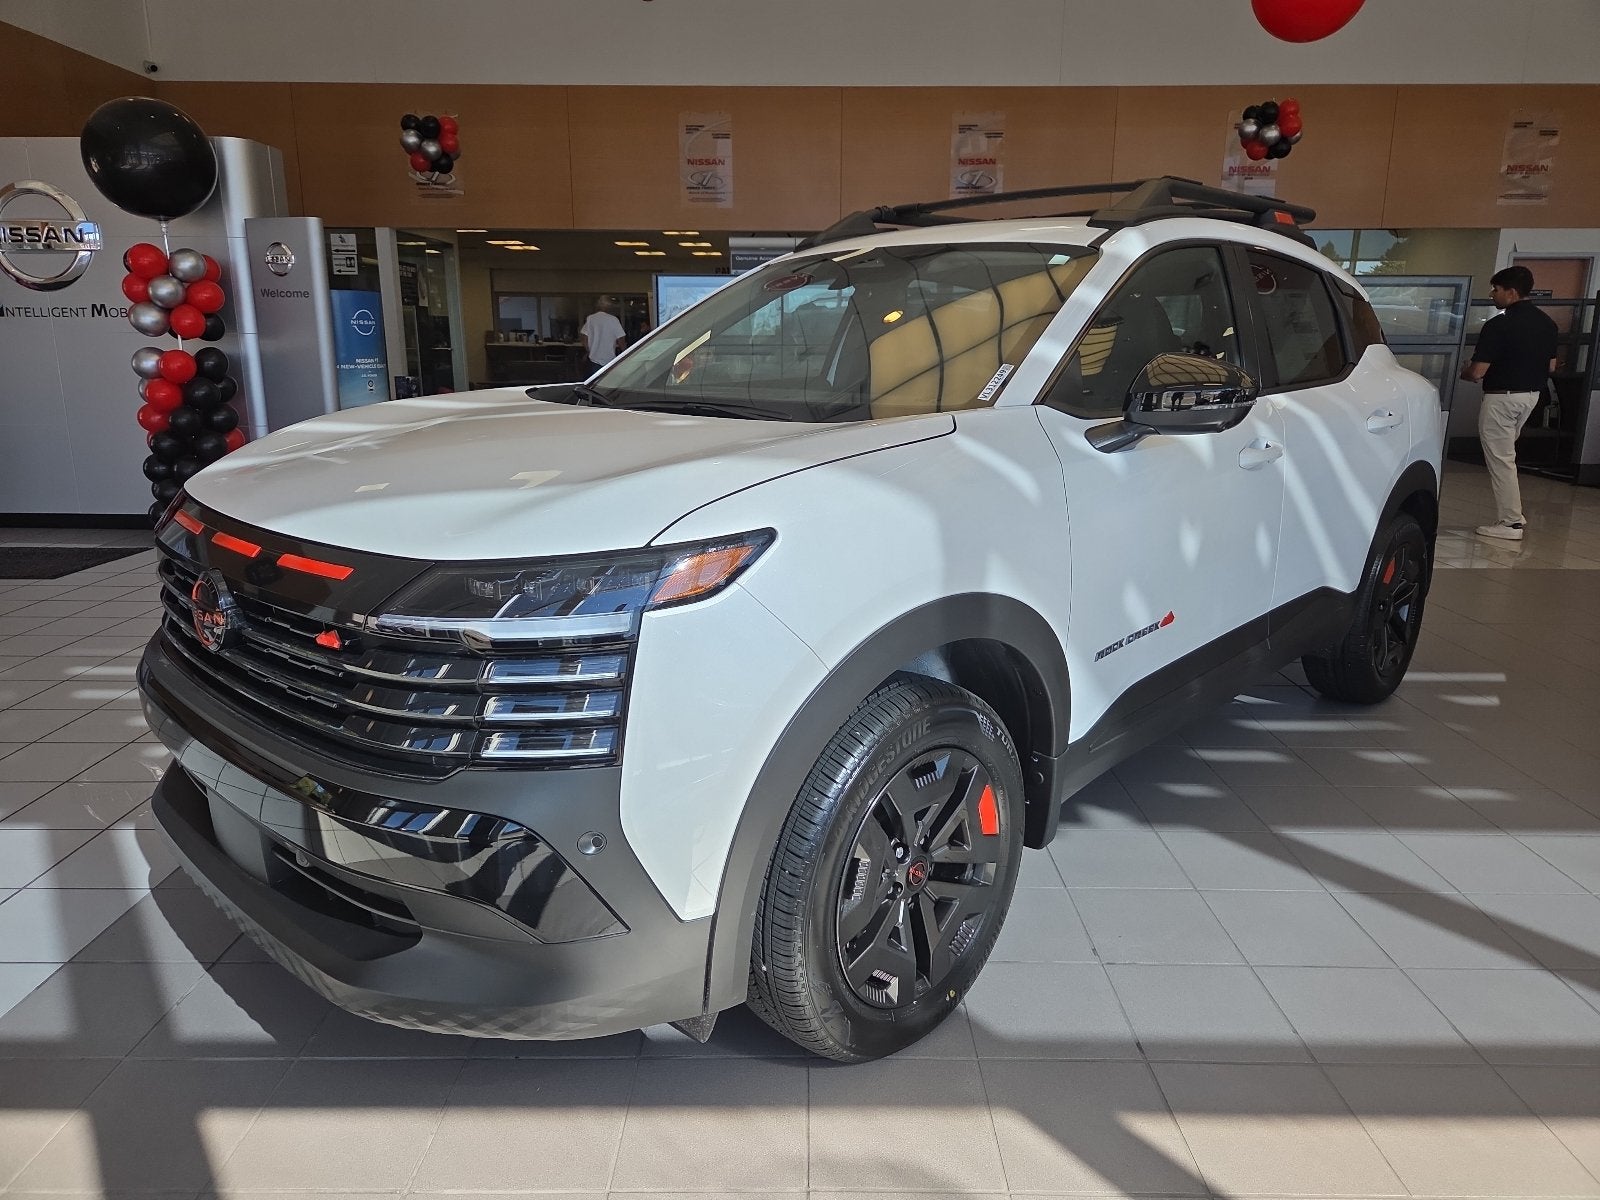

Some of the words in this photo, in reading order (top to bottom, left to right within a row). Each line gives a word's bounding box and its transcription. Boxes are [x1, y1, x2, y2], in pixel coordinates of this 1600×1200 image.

[687, 158, 726, 166] NISSAN
[958, 158, 997, 166] NISSAN
[1228, 165, 1271, 174] NISSAN
[1506, 164, 1549, 172] NISSAN
[0, 226, 84, 243] ISSAN
[260, 288, 310, 298] Welcome
[91, 303, 129, 318] MOB
[1094, 638, 1125, 662] ROCK
[1125, 620, 1161, 646] CREEK
